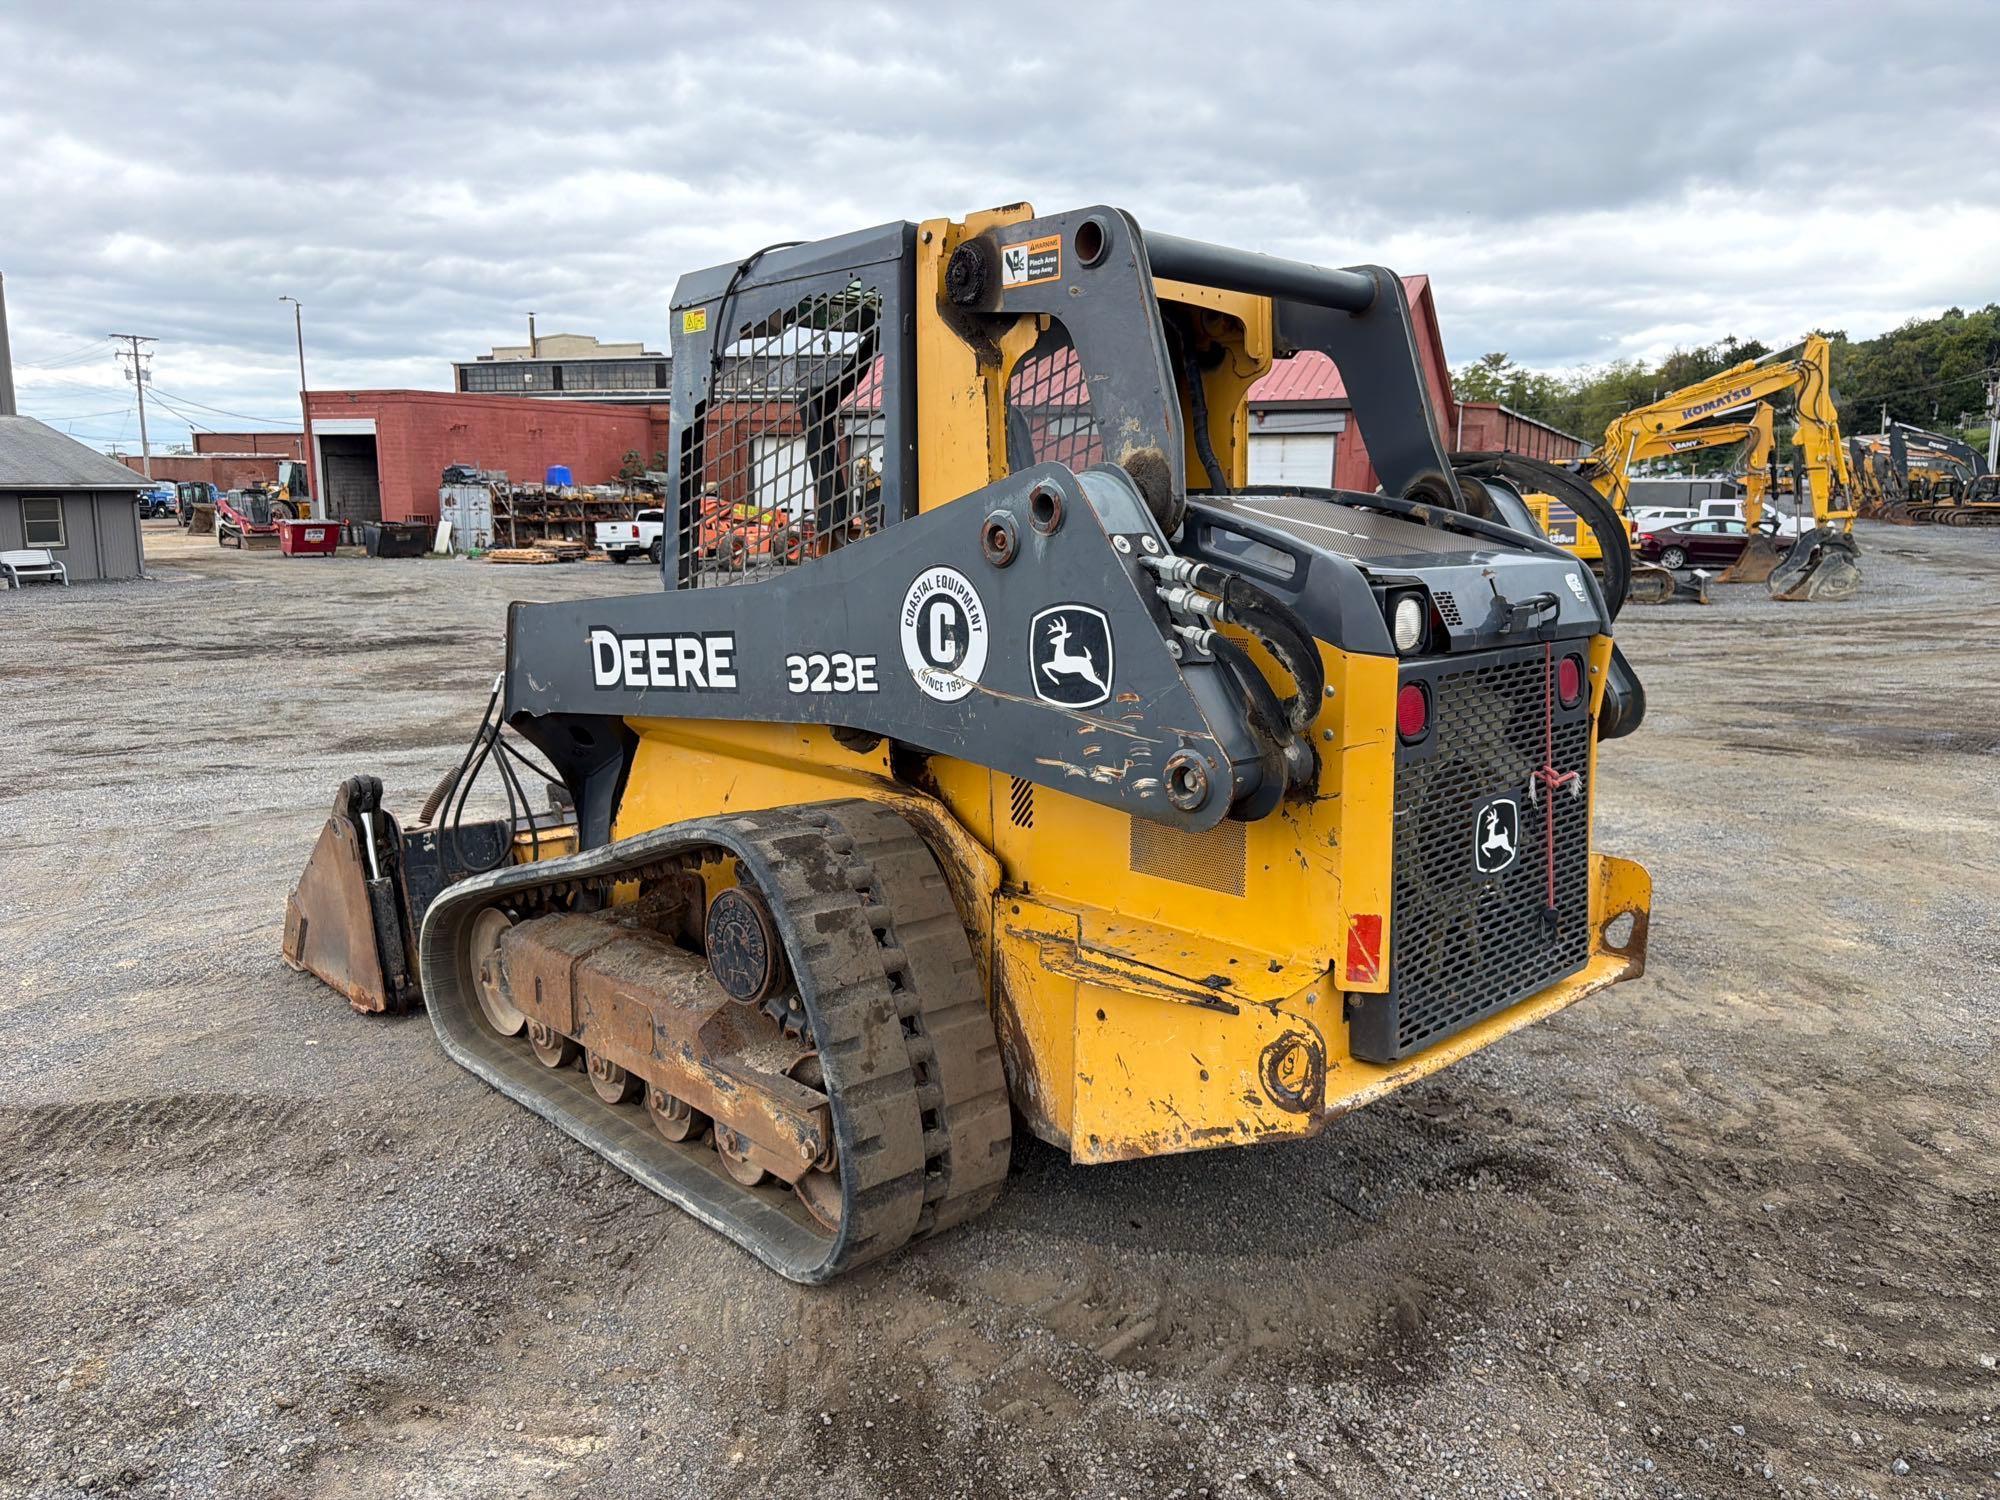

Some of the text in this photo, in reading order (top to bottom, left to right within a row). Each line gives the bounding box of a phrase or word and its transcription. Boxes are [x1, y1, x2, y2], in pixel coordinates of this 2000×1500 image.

[1035, 239, 1058, 249] WARNING
[1029, 256, 1057, 267] Pinch Area
[1682, 387, 1752, 420] KOMATSU
[1675, 440, 1698, 450] SANY
[1928, 441, 1949, 451] DEERE
[905, 575, 982, 633] COASTAL EQUIPMENT
[929, 602, 956, 663] C
[591, 630, 737, 688] DEERE
[786, 653, 878, 692] 323E
[920, 671, 967, 693] SINCE 1952
